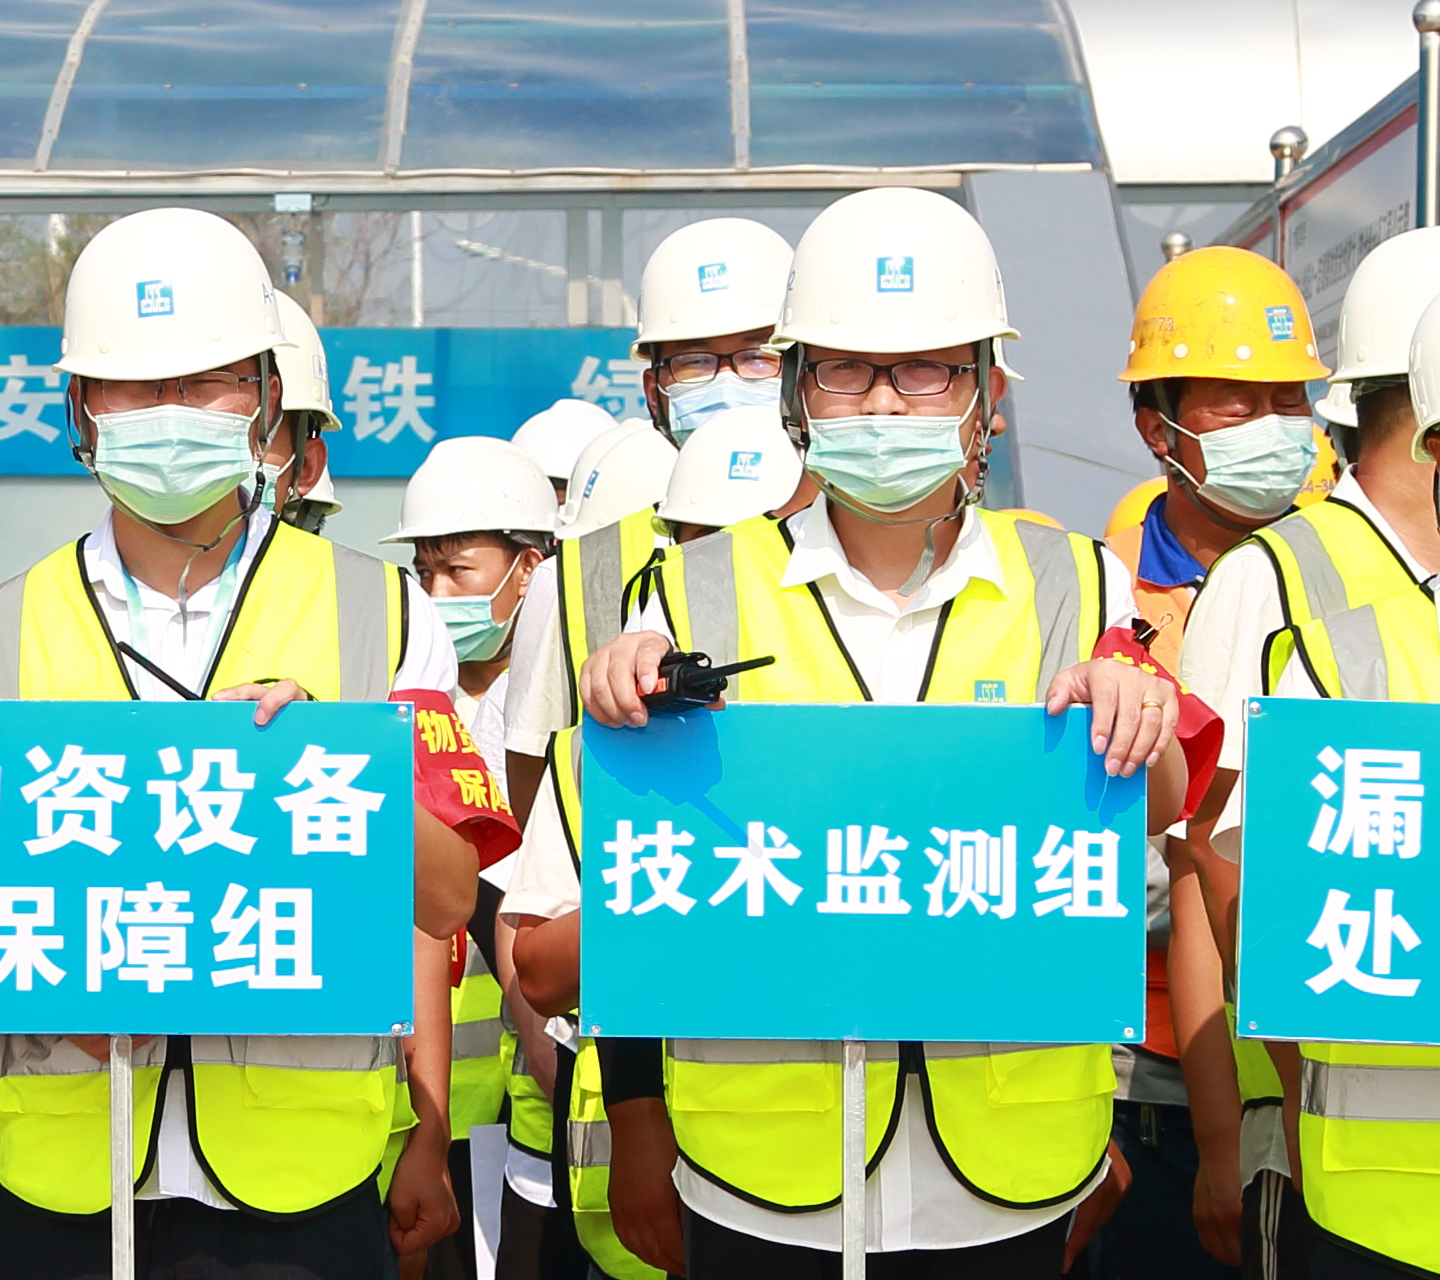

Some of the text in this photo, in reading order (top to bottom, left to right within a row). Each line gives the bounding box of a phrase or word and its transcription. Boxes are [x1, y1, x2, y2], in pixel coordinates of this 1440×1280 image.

[601, 819, 1130, 920] 技术监测组
